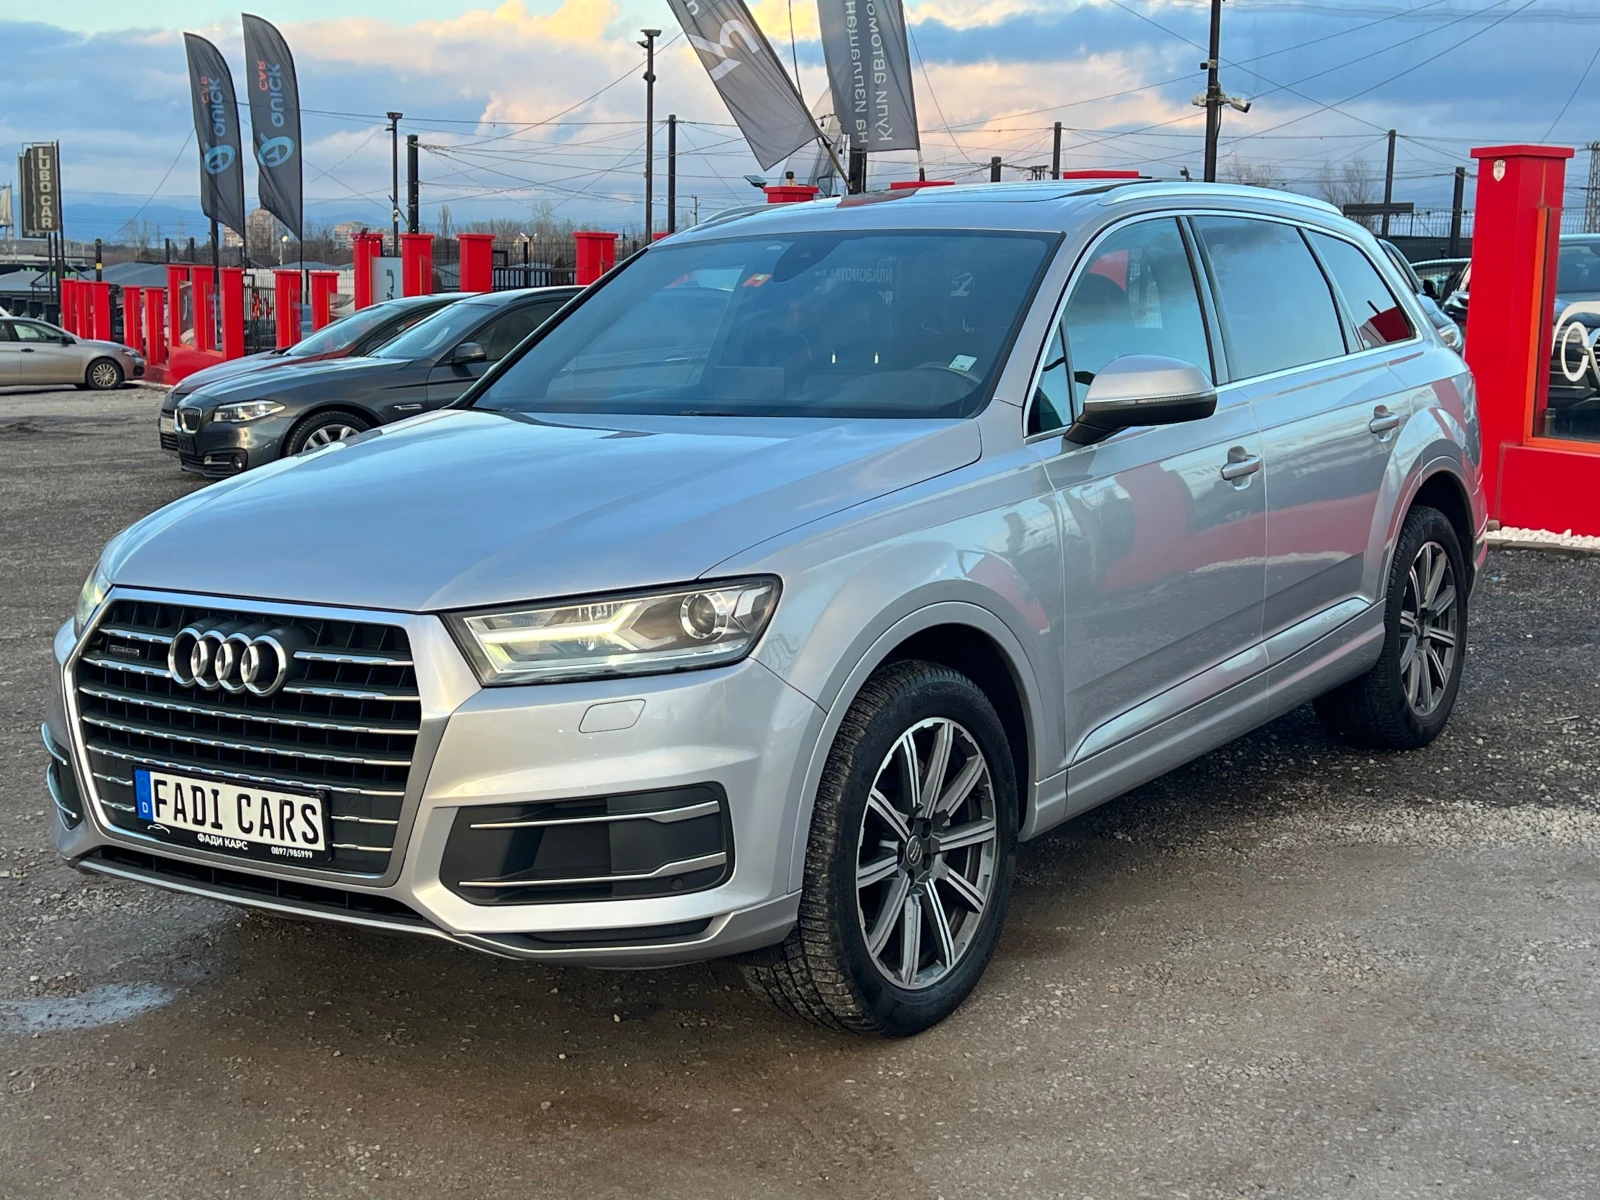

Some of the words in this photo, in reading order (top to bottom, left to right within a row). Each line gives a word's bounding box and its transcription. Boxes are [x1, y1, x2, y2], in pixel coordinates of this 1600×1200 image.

[38, 147, 52, 193] LUBO
[40, 195, 53, 229] CAR
[142, 802, 149, 813] D
[153, 779, 223, 830] FADI
[236, 793, 320, 844] CARS
[197, 833, 223, 847] ФАДИ
[224, 837, 248, 850] КАРС
[270, 846, 313, 859] 0897/985999
